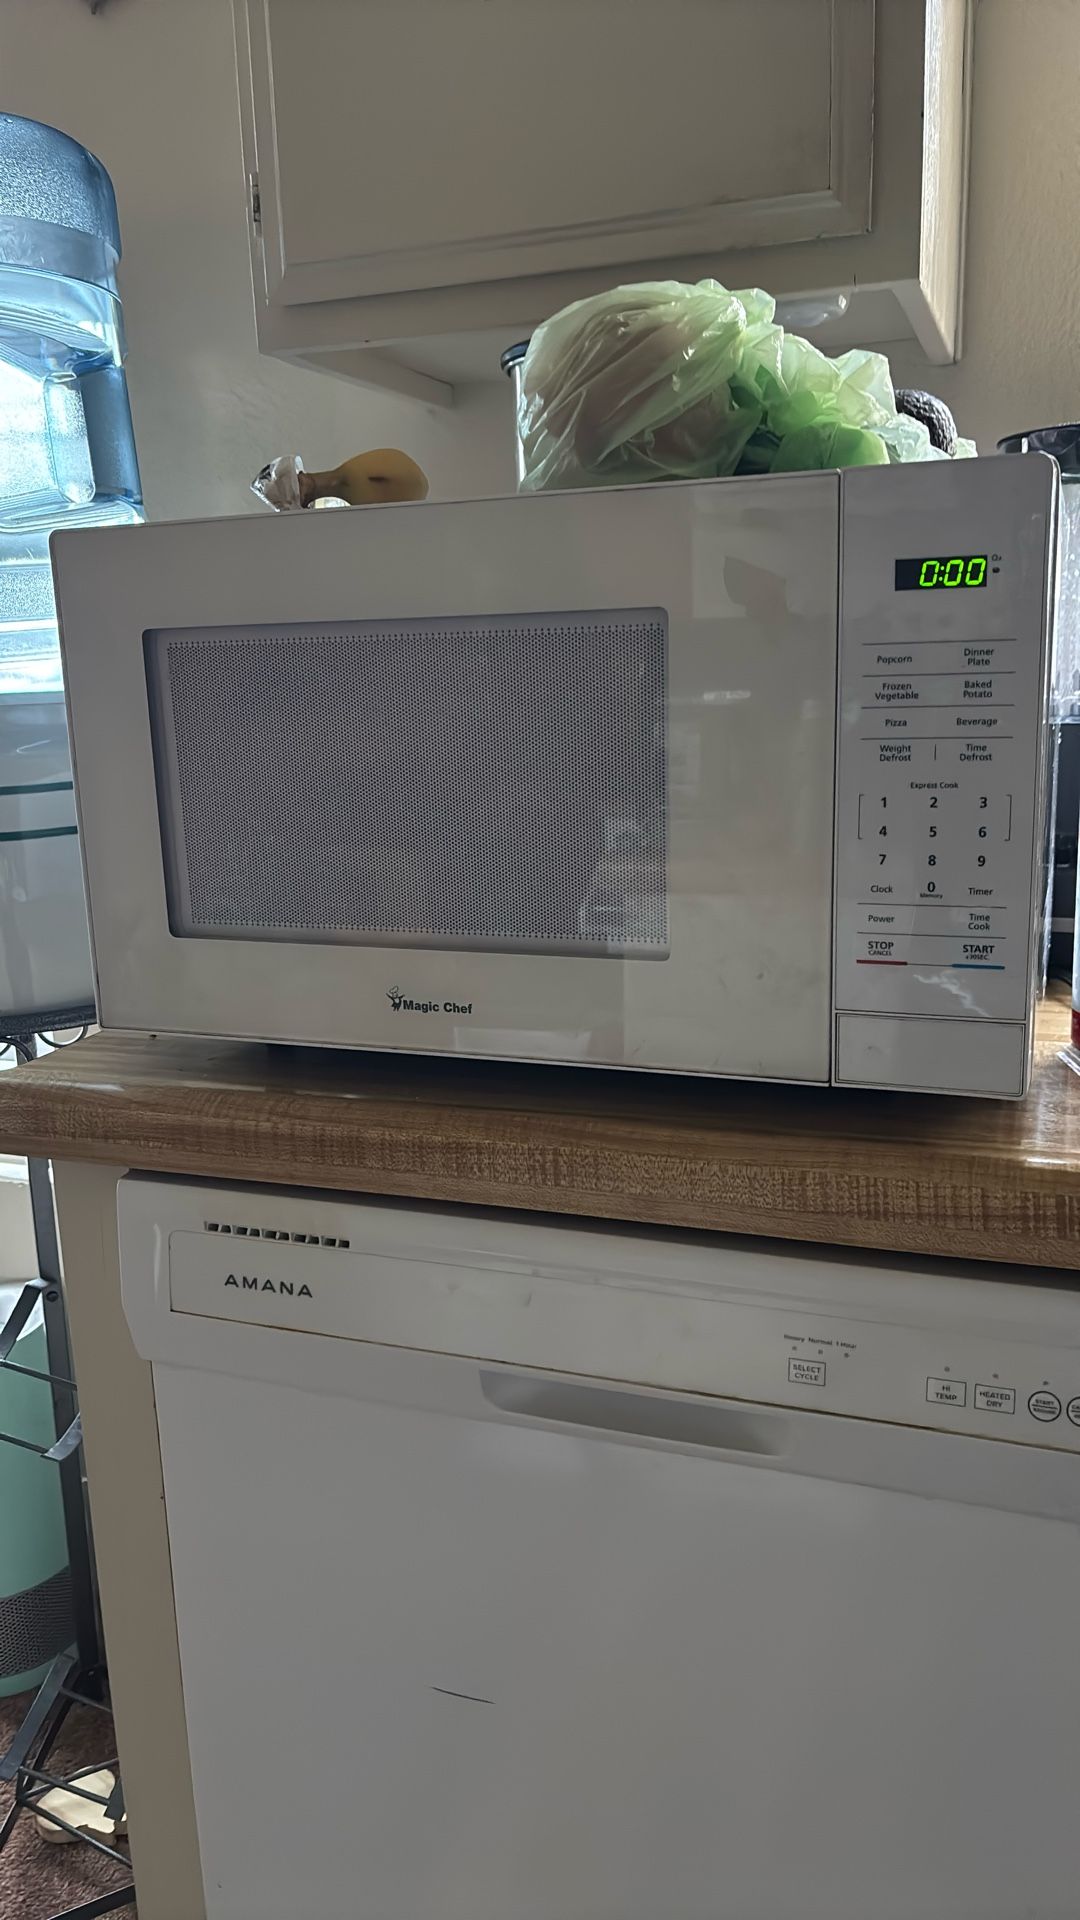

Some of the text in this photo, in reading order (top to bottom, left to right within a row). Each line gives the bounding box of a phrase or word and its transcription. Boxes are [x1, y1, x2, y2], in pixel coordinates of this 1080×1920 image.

[919, 558, 987, 587] 0:00
[964, 648, 995, 657] Dinner
[877, 655, 913, 665] Popcorn
[967, 658, 991, 666] Plate
[882, 683, 912, 691] Frozen
[964, 680, 992, 689] Baked
[875, 691, 919, 702] Vegetable
[963, 690, 993, 698] Potato
[885, 719, 907, 727] Pizza
[956, 718, 998, 728] Beverage
[880, 744, 912, 754] Weight
[966, 744, 987, 752] Time
[879, 753, 912, 762] Defrost
[959, 753, 993, 762] Defrost
[910, 782, 938, 791] Express
[880, 796, 887, 808] 1
[929, 796, 938, 808] 2
[979, 796, 988, 808] 3
[878, 825, 888, 837] 4
[929, 826, 937, 837] 5
[978, 826, 987, 838] 6
[878, 854, 887, 865] 7
[928, 854, 937, 866] 8
[977, 855, 986, 867] 9
[870, 885, 893, 894] Clock
[927, 881, 936, 892] 0
[968, 887, 994, 896] Timer
[868, 914, 895, 923] Power
[969, 913, 991, 921] Time
[968, 922, 991, 931] Cook
[868, 941, 894, 950] STOP
[963, 944, 995, 954] START
[403, 1000, 472, 1014] Magic Chef
[224, 1274, 313, 1298] AMANA
[793, 1364, 821, 1374] SELECT
[794, 1373, 819, 1381] CYCLE
[935, 1392, 957, 1400] TEMP
[979, 1391, 1011, 1401] HEATED
[986, 1400, 1003, 1408] DRY
